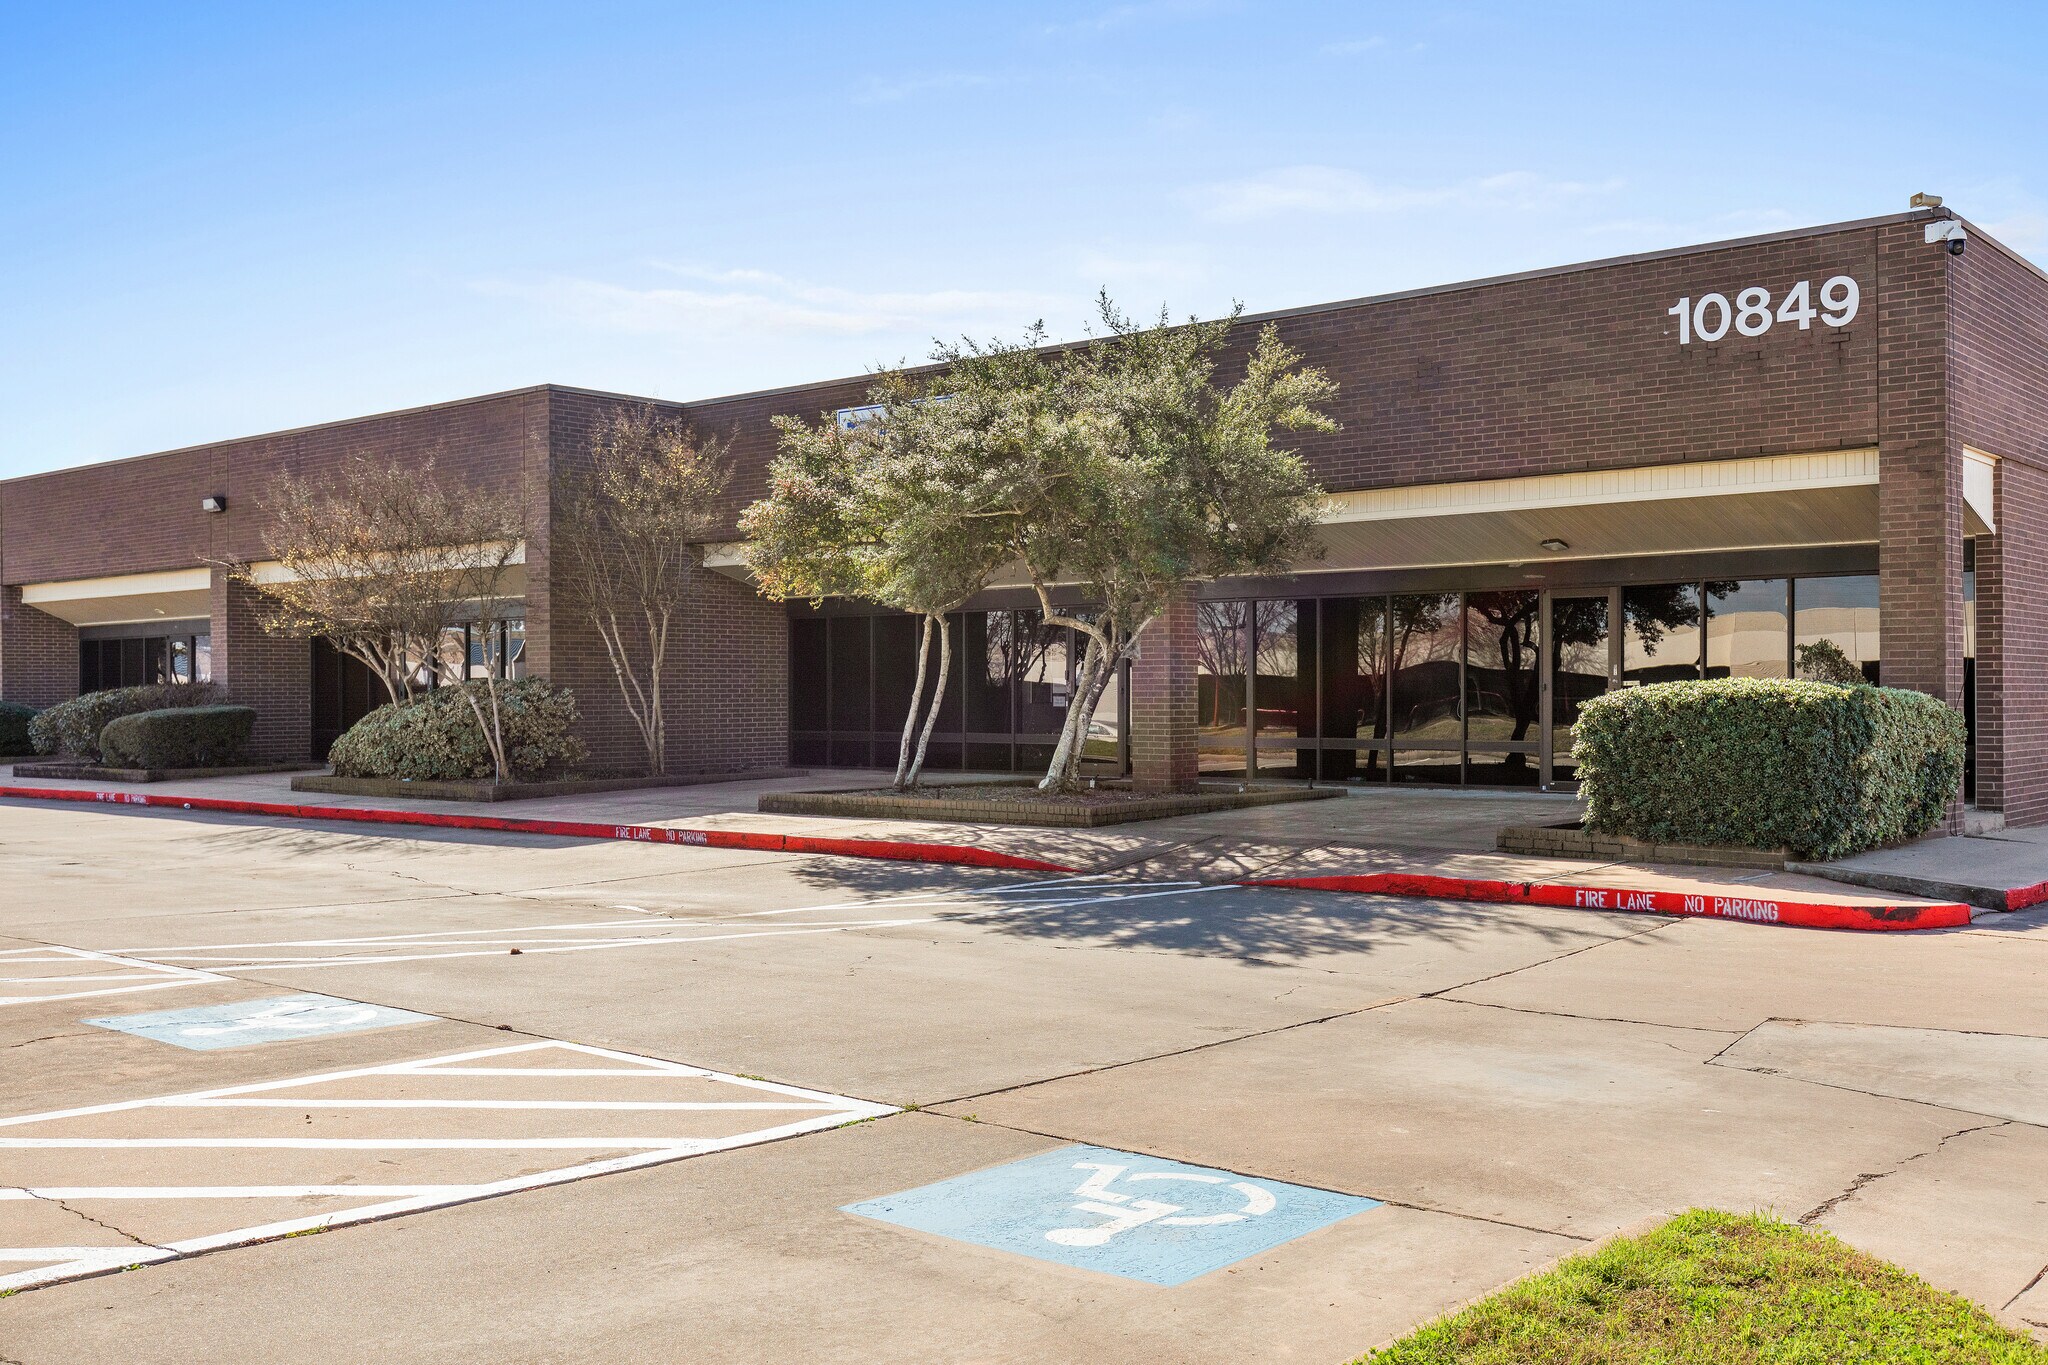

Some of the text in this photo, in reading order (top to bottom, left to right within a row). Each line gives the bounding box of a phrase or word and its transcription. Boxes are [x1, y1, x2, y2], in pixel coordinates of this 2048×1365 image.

[1668, 275, 1860, 345] 10849
[615, 827, 707, 843] FIRE LANE NO PARKING
[1575, 889, 1779, 922] FIRE LANE NO PARKING
